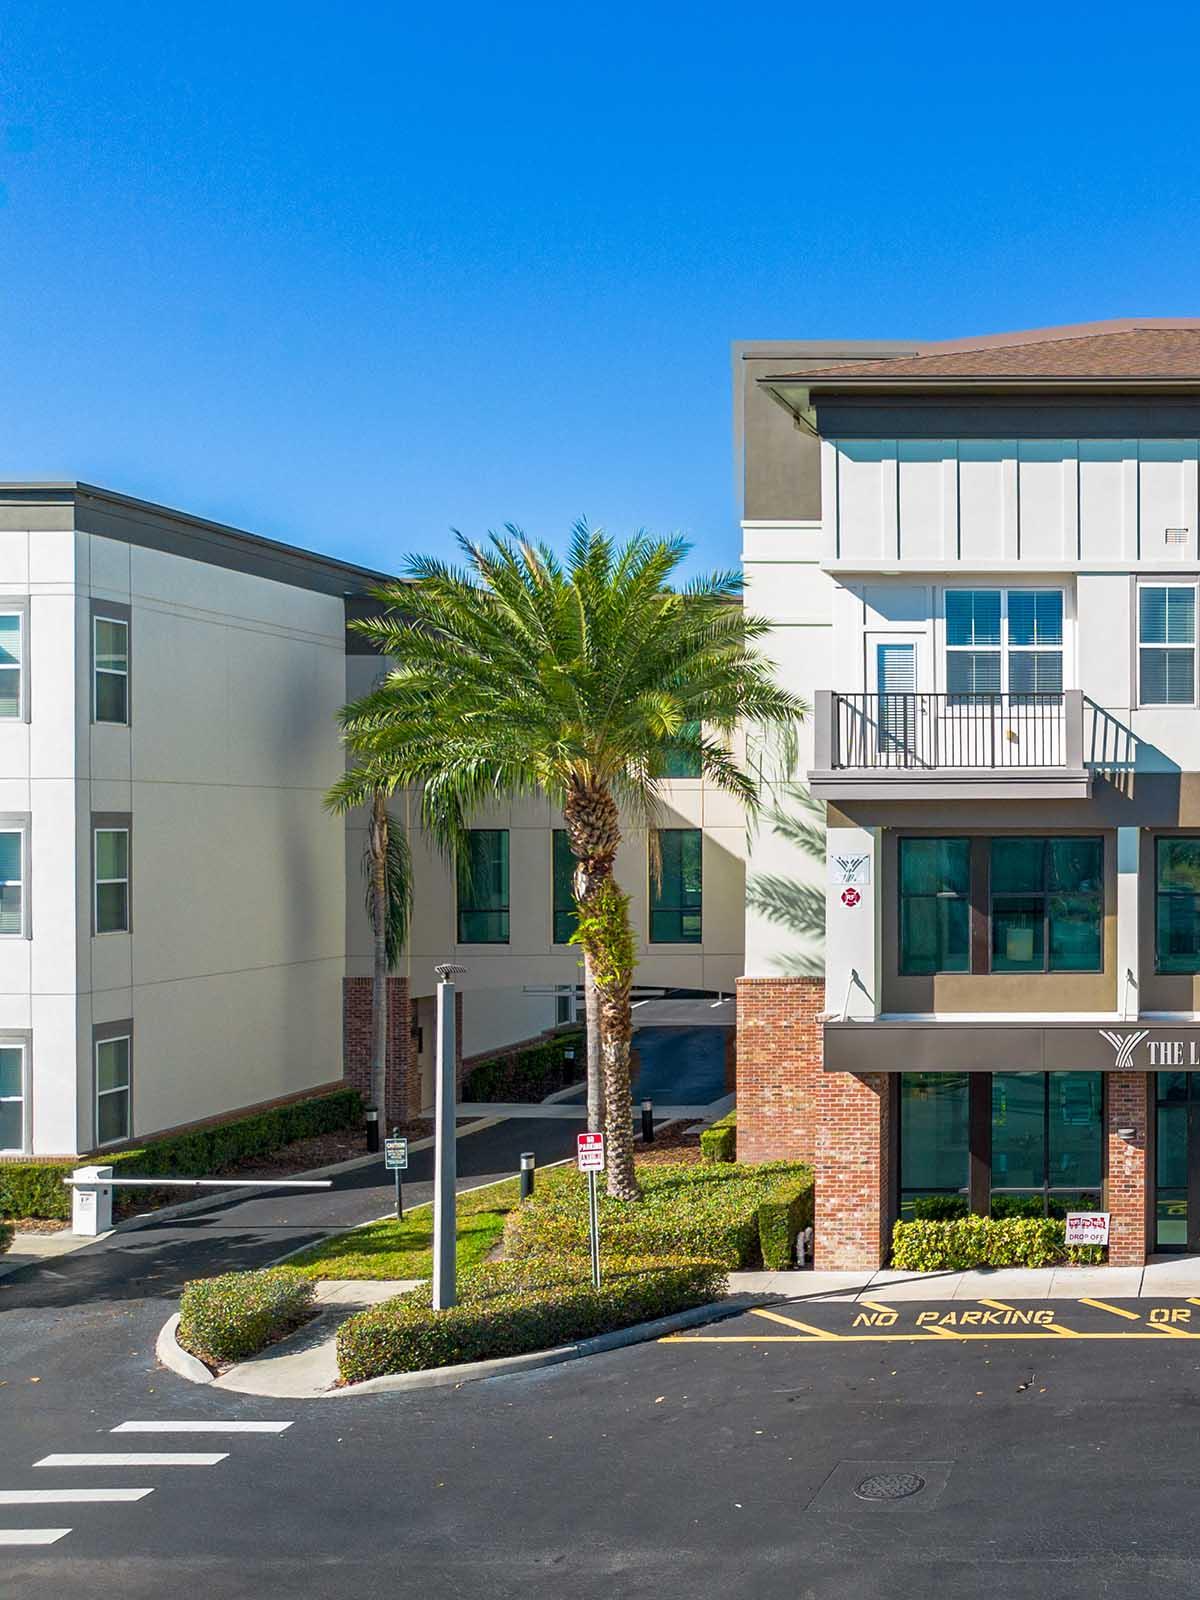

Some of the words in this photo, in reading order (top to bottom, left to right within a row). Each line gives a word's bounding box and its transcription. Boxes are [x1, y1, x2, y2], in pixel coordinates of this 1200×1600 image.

[1147, 1041, 1184, 1065] THE
[1069, 1233, 1089, 1241] DROP
[852, 1312, 899, 1327] NO
[915, 1310, 1055, 1325] PARKING
[1150, 1308, 1192, 1323] OR
